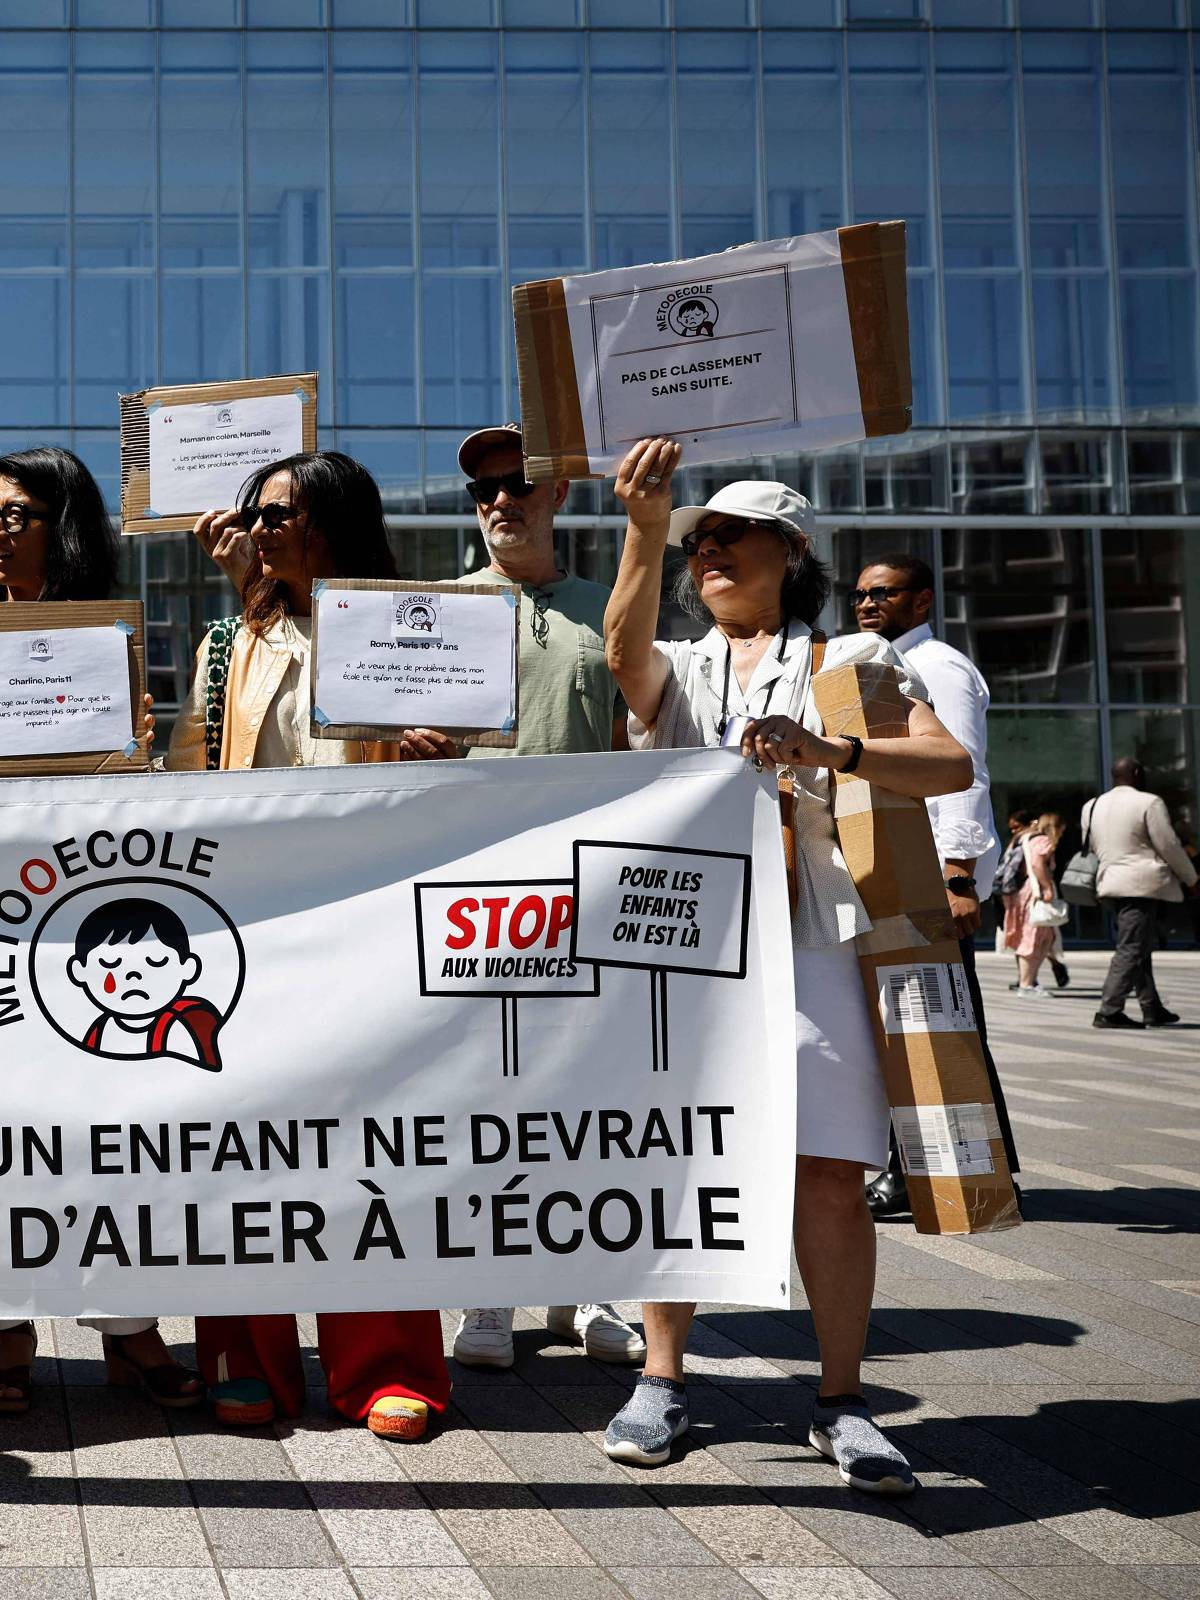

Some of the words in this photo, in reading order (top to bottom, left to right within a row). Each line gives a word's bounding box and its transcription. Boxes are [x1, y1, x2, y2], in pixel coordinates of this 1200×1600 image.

[656, 284, 713, 333] METOOECOLE
[620, 368, 648, 384] PAS
[649, 366, 668, 380] DE
[669, 352, 763, 376] CLASSEMENT
[651, 381, 688, 397] SANS
[689, 375, 734, 392] SUITE.
[179, 436, 206, 444] Maman
[239, 429, 271, 438] Marseille
[270, 447, 282, 455] plus
[370, 640, 396, 650] Romy,
[396, 640, 420, 650] Paris
[419, 641, 430, 650] 10
[435, 642, 442, 650] 9
[342, 671, 360, 681] école
[373, 673, 392, 683] qu'on
[405, 674, 426, 684] fasse
[427, 676, 441, 684] plus
[443, 676, 453, 684] de
[356, 661, 366, 670] Je
[387, 663, 401, 672] plus
[403, 663, 412, 671] de
[414, 663, 447, 673] problème
[448, 664, 467, 674] dans
[8, 676, 45, 686] Charline,
[45, 675, 65, 684] Paris
[67, 694, 85, 703] Pour
[87, 696, 100, 704] que
[23, 709, 49, 718] puissent
[51, 707, 64, 716] plus
[65, 708, 79, 716] agir
[92, 706, 112, 714] toute
[25, 717, 52, 728] impunité
[618, 866, 668, 889] POUR
[670, 870, 703, 893] LES
[620, 894, 699, 920] ENFANTS
[445, 894, 574, 950] STOP
[612, 922, 641, 943] ON
[643, 925, 675, 947] EST
[680, 920, 701, 948] LÀ
[441, 957, 479, 978] AUX
[484, 957, 578, 978] VIOLENCES
[90, 1118, 340, 1176] ENFANT
[363, 1115, 448, 1168] NE
[471, 1105, 735, 1165] DEVRAIT
[10, 1200, 329, 1270] D'ALLER
[353, 1178, 407, 1261] À
[434, 1174, 746, 1260] L'ÉCOLE
